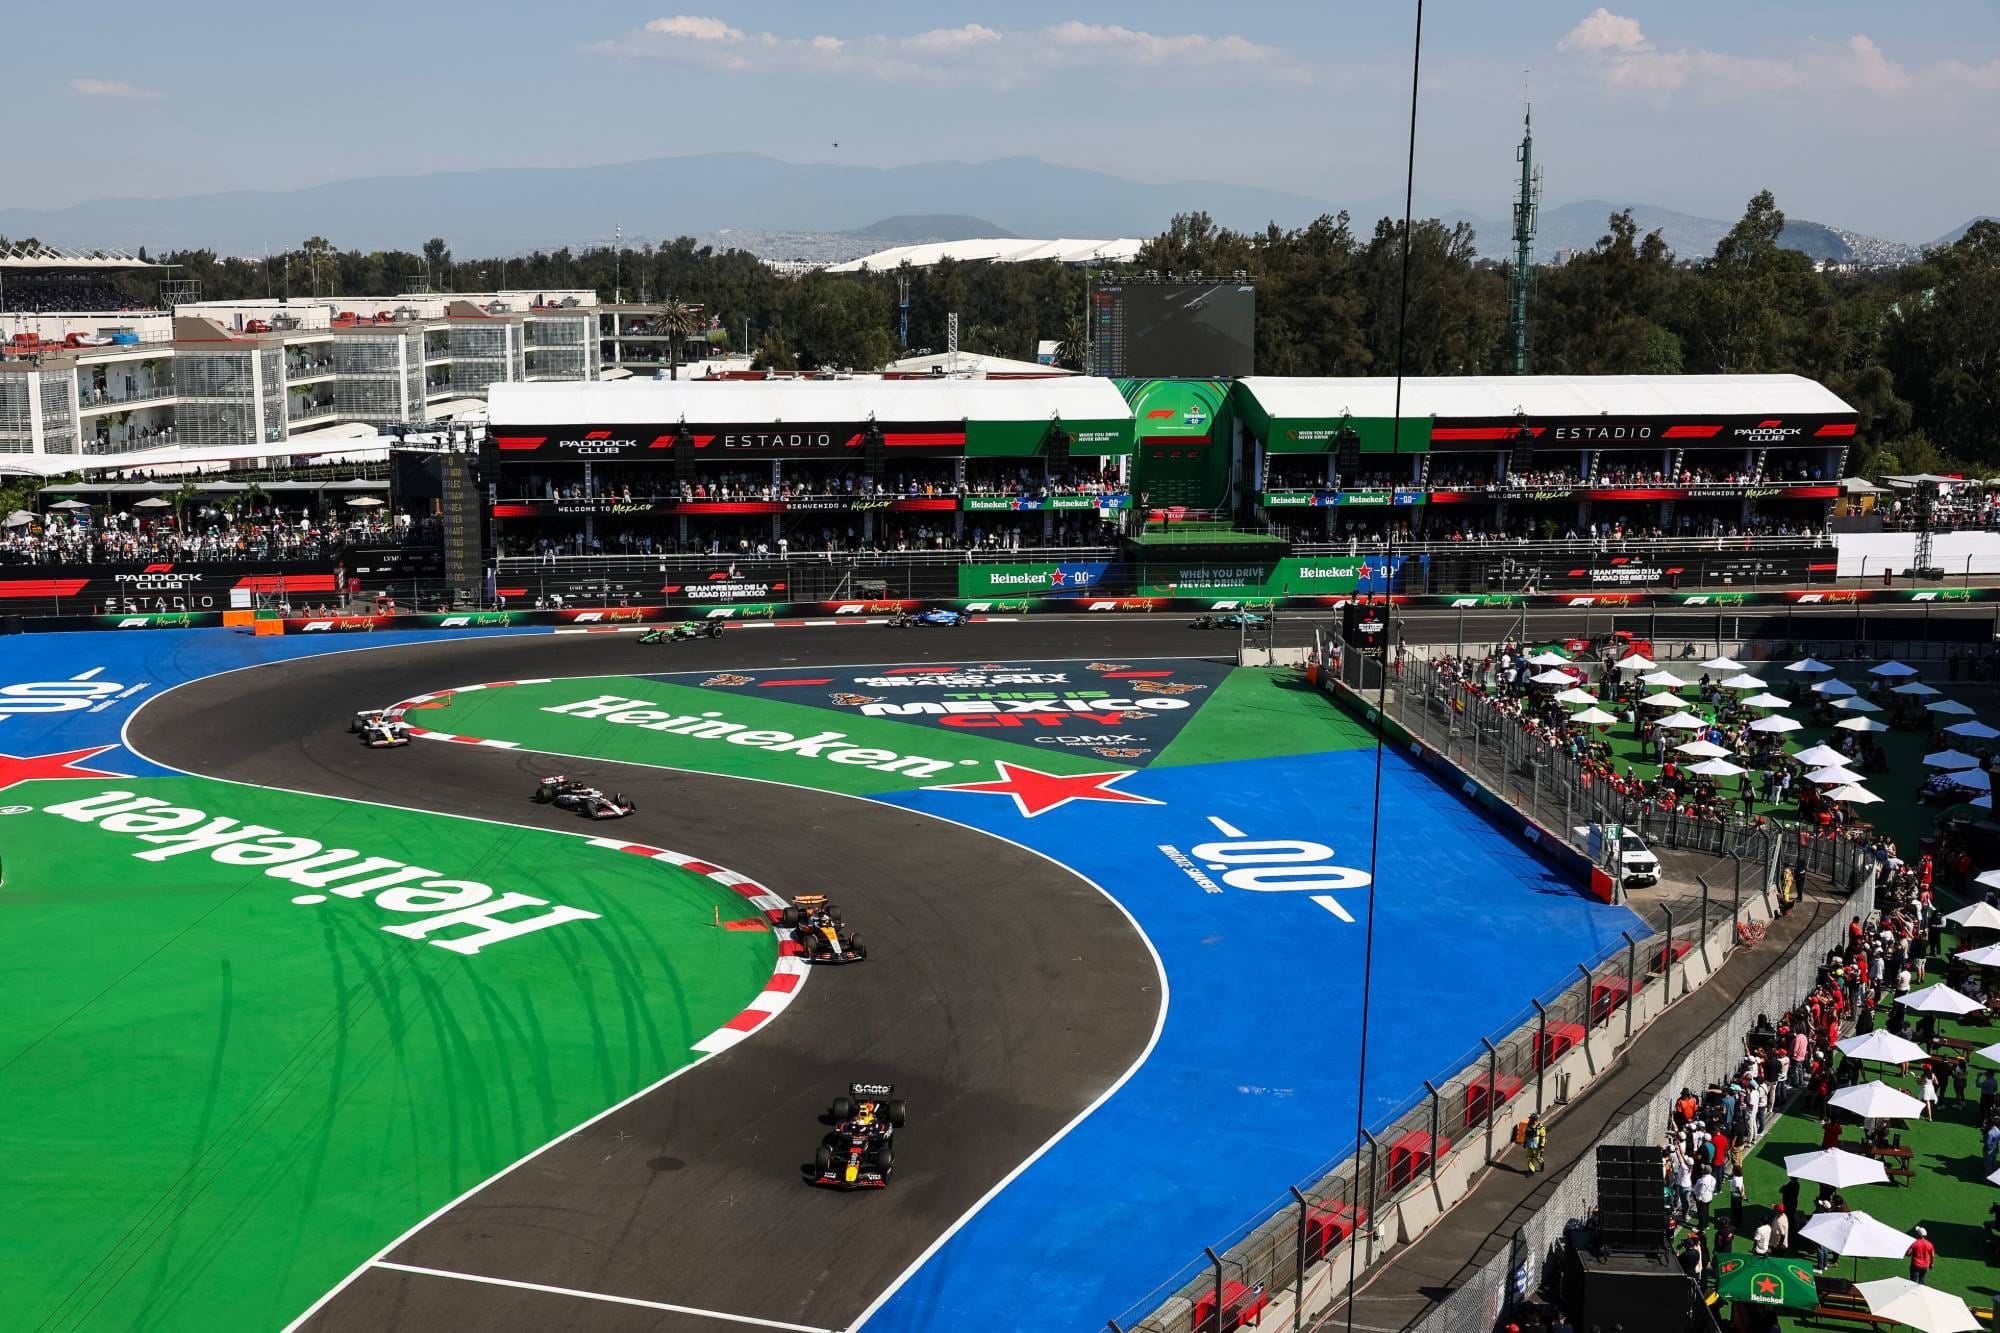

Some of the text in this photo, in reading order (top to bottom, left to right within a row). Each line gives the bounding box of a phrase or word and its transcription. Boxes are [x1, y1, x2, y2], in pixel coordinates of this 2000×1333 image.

[1556, 427, 1651, 439] ESTADIO
[1734, 428, 1801, 436] PADDOCK
[559, 440, 637, 448] PADDOCK
[725, 434, 830, 447] ESTADIO
[450, 480, 461, 488] LEC
[1535, 489, 1573, 501] Mexico
[1745, 487, 1782, 498] Mexico
[851, 499, 892, 511] Mexico
[1053, 499, 1088, 507] Heineken
[1271, 496, 1305, 504] Heineken
[612, 502, 653, 514] Mexico
[114, 573, 202, 582] PADDOCK
[990, 572, 1047, 584] Heineken
[1179, 568, 1264, 579] WHEN YOU DRIVE
[1300, 566, 1354, 578] Heineken
[136, 582, 183, 590] CLUB
[1179, 578, 1245, 588] NEVER DRINK
[1619, 594, 1629, 607] City
[1733, 593, 1744, 606] City
[1847, 590, 1858, 604] City
[1960, 589, 1970, 602] City
[106, 596, 214, 609] ESTADIO
[891, 601, 903, 616] City
[1018, 600, 1030, 614] City
[1142, 599, 1153, 613] City
[1264, 598, 1276, 612] City
[1502, 595, 1513, 610] City
[630, 608, 643, 624] City
[762, 604, 775, 619] City
[178, 612, 192, 628] City
[362, 618, 375, 632] City
[498, 613, 511, 628] City
[854, 674, 987, 684] MEXICO
[866, 679, 986, 687] GRAND
[944, 690, 1111, 700] THIS IS
[860, 698, 1191, 716] MEXICO
[939, 712, 1126, 728] CITY
[542, 695, 958, 778] Heineken
[42, 790, 603, 955] Heineken
[1191, 840, 1372, 892] 0.0
[1751, 1294, 1784, 1304] Heineken
